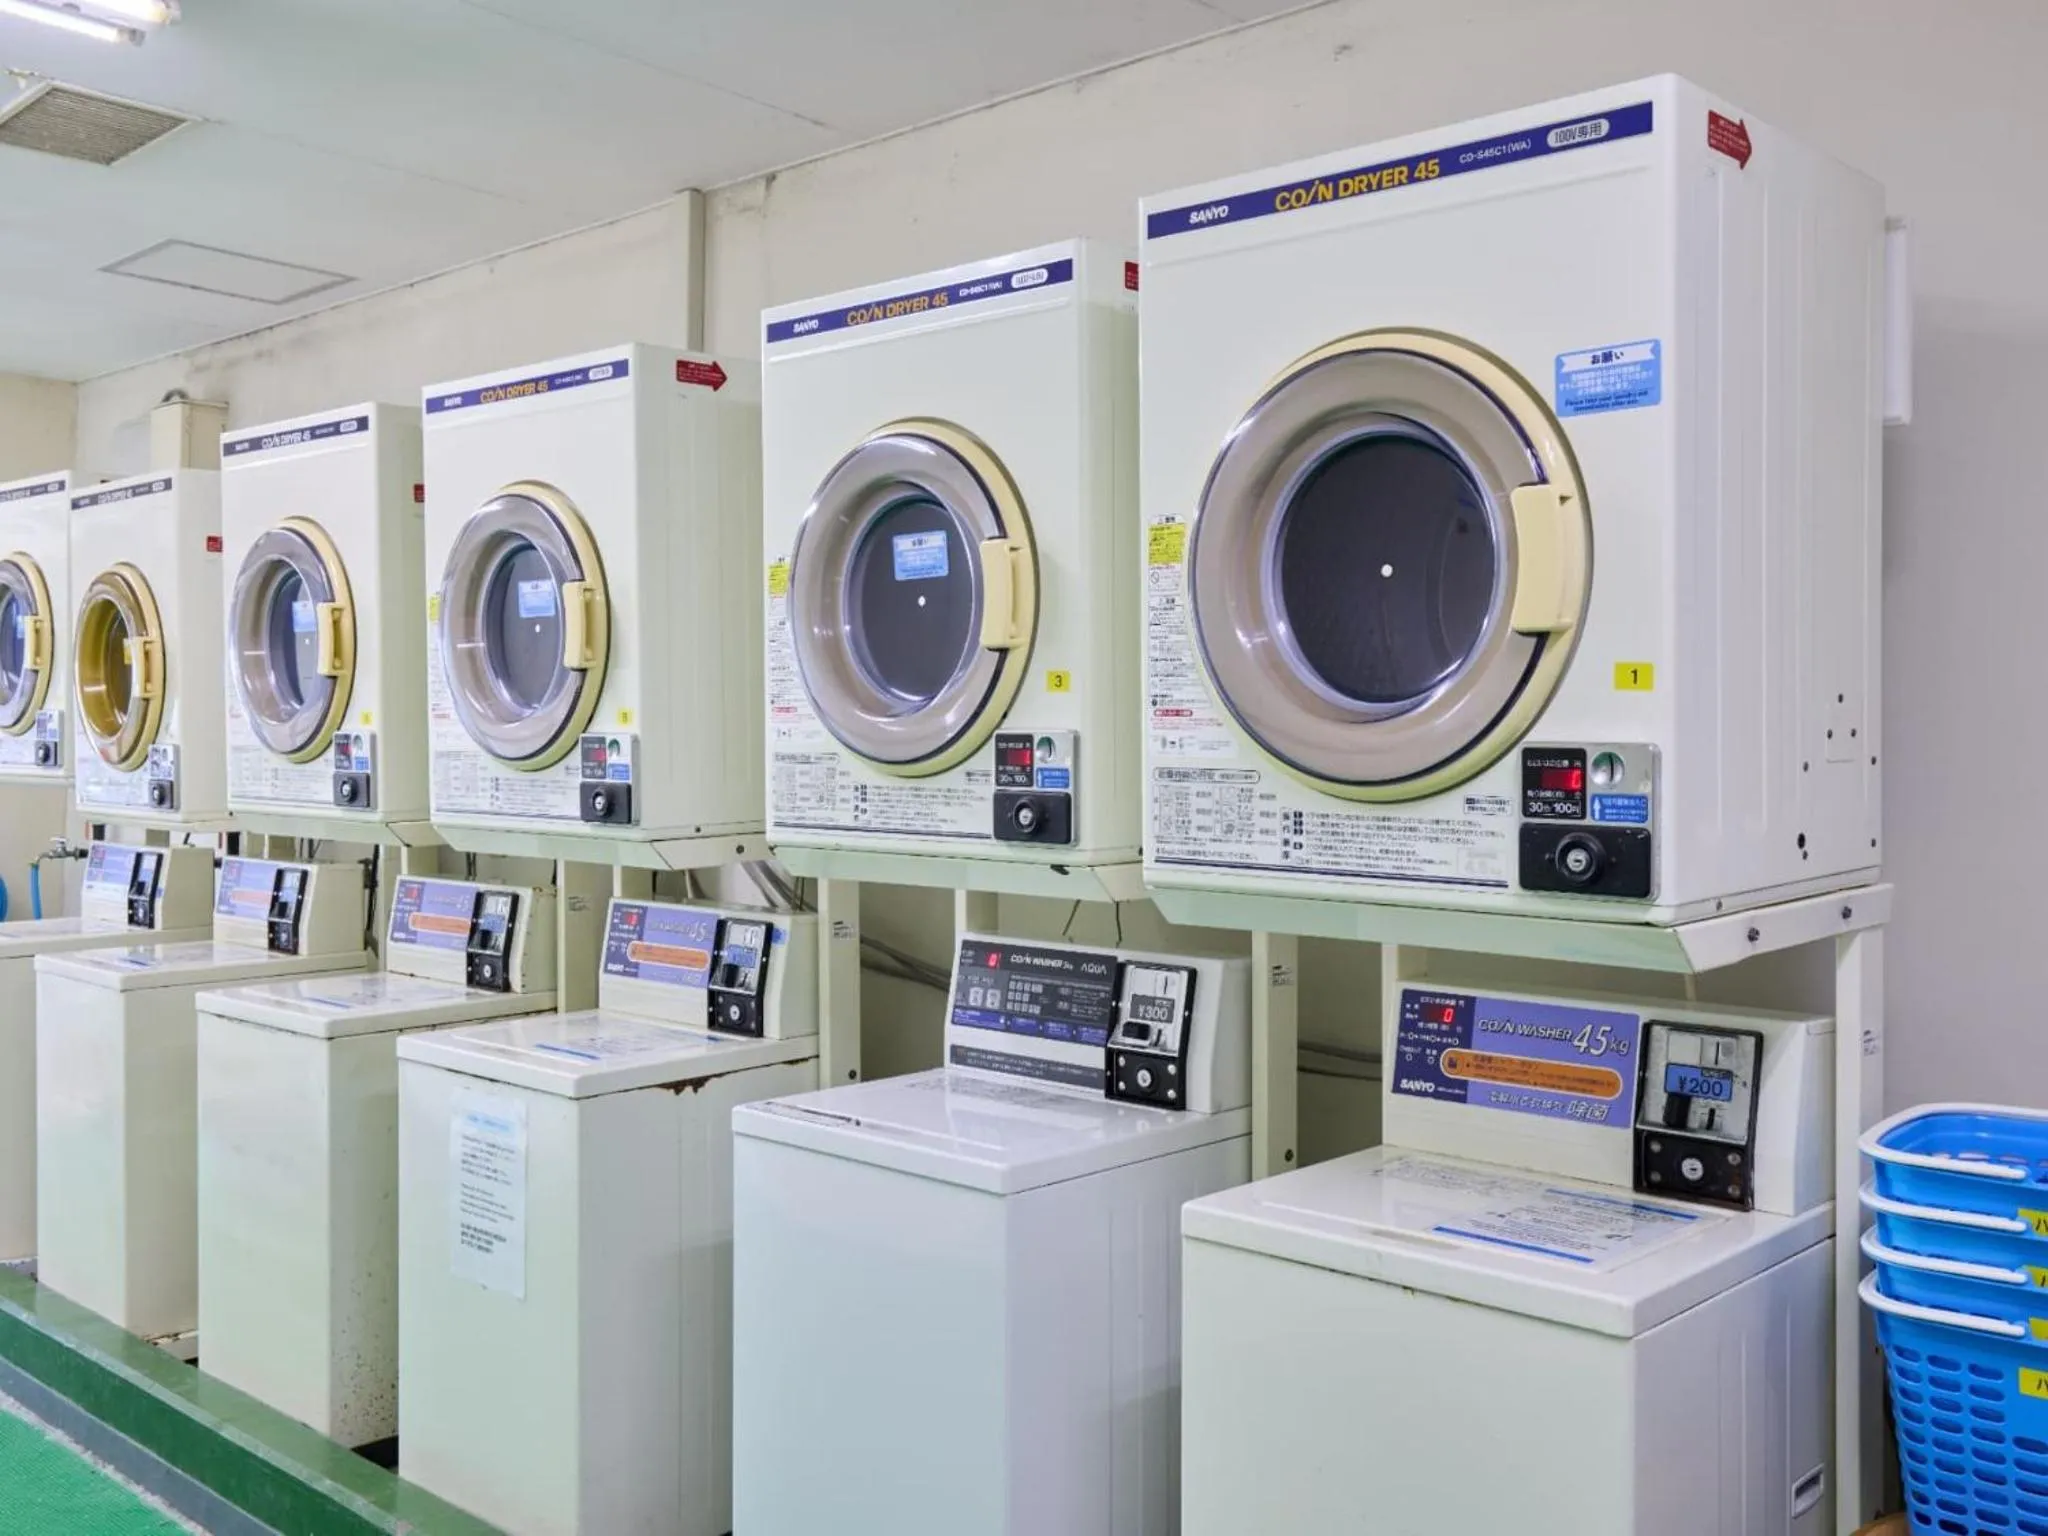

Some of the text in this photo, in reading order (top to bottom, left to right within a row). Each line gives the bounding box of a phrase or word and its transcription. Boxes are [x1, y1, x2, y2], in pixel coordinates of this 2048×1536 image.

[1190, 205, 1229, 224] SANYO
[1338, 166, 1408, 198] DRYER
[1414, 159, 1440, 180] 45
[793, 319, 819, 333] SANYO
[886, 296, 929, 318] DRYER
[932, 292, 948, 307] 45
[1054, 675, 1063, 688] 3
[1630, 668, 1638, 685] 1
[1138, 1004, 1168, 1020] ¥300
[1443, 1007, 1454, 1023] 0
[1517, 1022, 1572, 1040] WASHER
[1400, 1078, 1435, 1093] SANYO
[1679, 1075, 1723, 1097] ¥200
